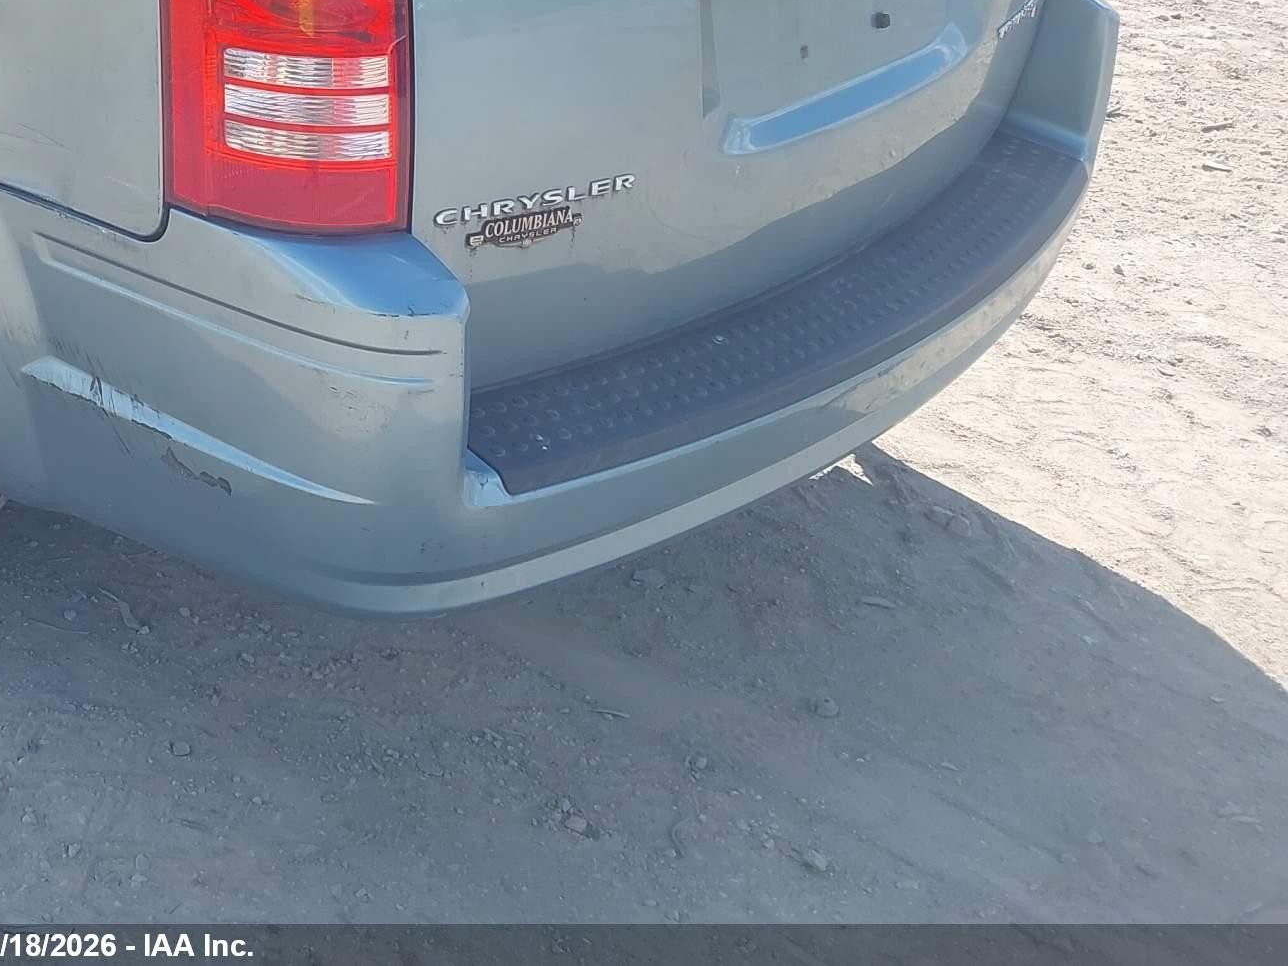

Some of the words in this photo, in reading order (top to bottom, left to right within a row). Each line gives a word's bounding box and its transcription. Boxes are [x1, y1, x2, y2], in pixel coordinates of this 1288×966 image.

[433, 173, 636, 226] CHRYSLER
[485, 208, 574, 238] COLUMBIANA
[499, 227, 557, 243] CHRYSLER
